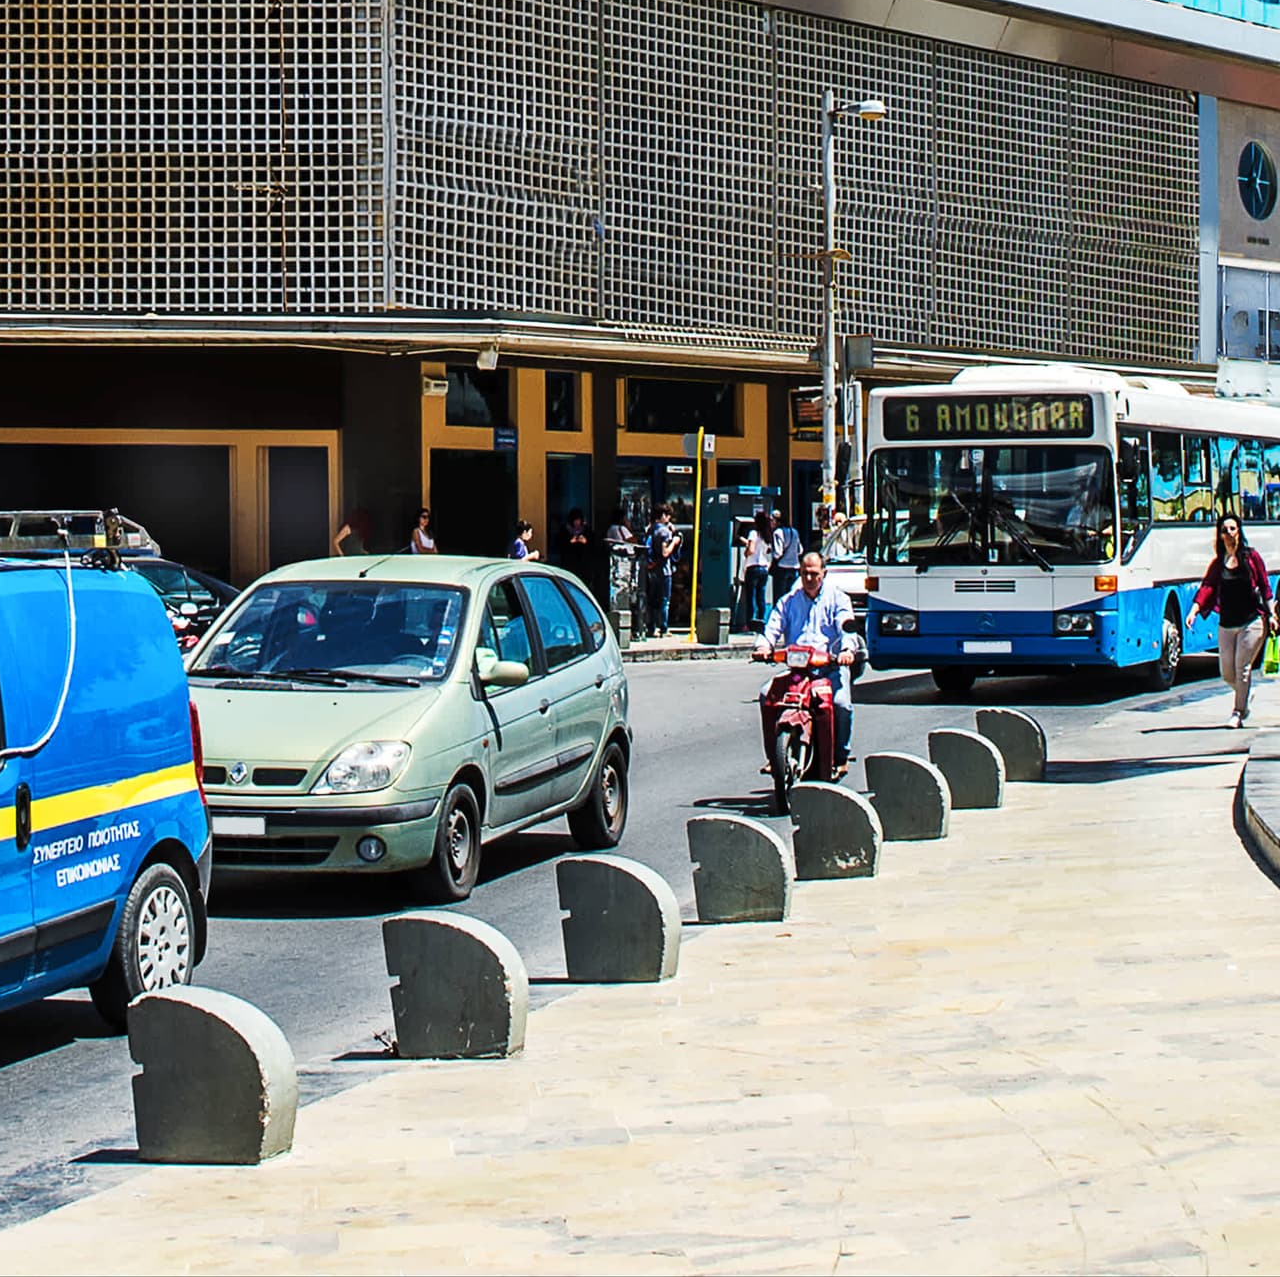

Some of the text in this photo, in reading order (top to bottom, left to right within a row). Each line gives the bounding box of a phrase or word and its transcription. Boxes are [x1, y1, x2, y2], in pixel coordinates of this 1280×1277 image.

[905, 404, 920, 432] 6
[33, 820, 141, 864] ΣΥΝΕΡΓΕΙΟ ΠΟΙΟΤΗΤΑΣ
